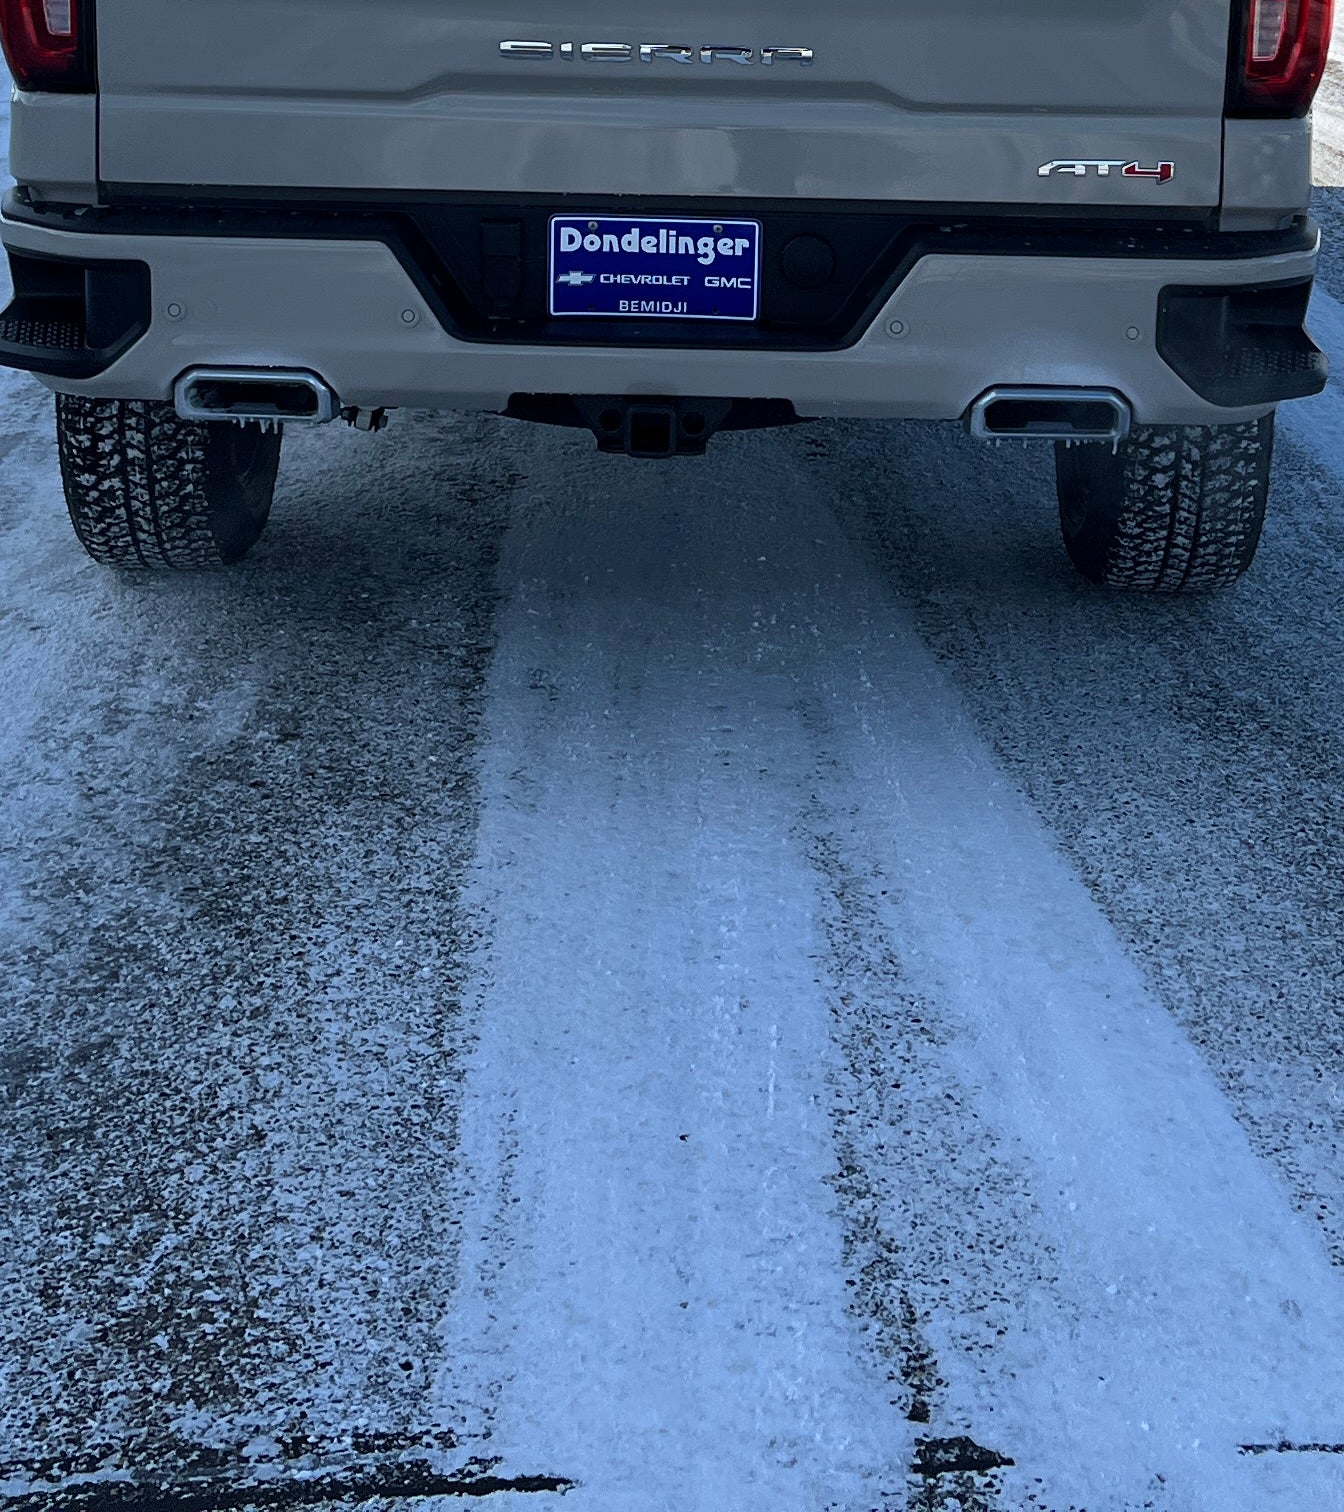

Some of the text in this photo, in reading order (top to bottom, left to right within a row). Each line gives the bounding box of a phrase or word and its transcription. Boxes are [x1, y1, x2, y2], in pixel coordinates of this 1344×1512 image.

[499, 40, 813, 66] SIERRA
[1038, 160, 1175, 185] AT4
[560, 226, 750, 265] Dondelinger
[599, 273, 752, 289] CHEVROLET GMC
[619, 300, 688, 313] BEMIDJI
